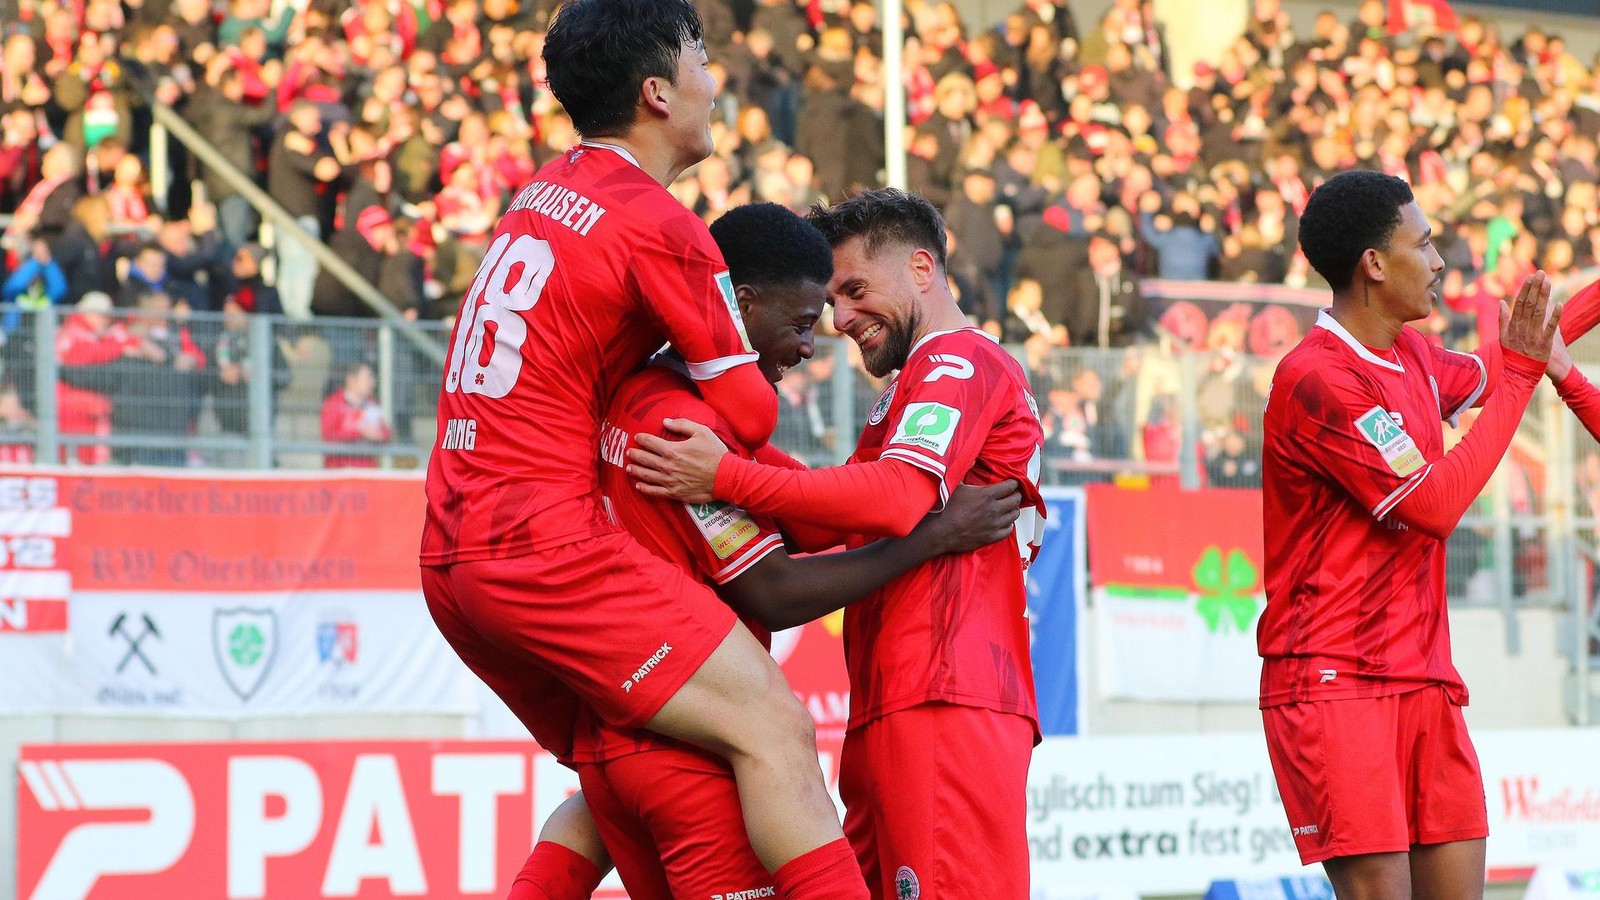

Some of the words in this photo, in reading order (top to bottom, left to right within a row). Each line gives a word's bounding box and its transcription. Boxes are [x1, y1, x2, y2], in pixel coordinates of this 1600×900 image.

[446, 233, 556, 399] 18
[631, 642, 673, 683] PATRICK
[1125, 783, 1184, 808] zum
[1192, 772, 1262, 815] Sieg!
[1073, 828, 1179, 859] extra
[1188, 819, 1242, 854] fest
[726, 886, 776, 900] PATRICK
